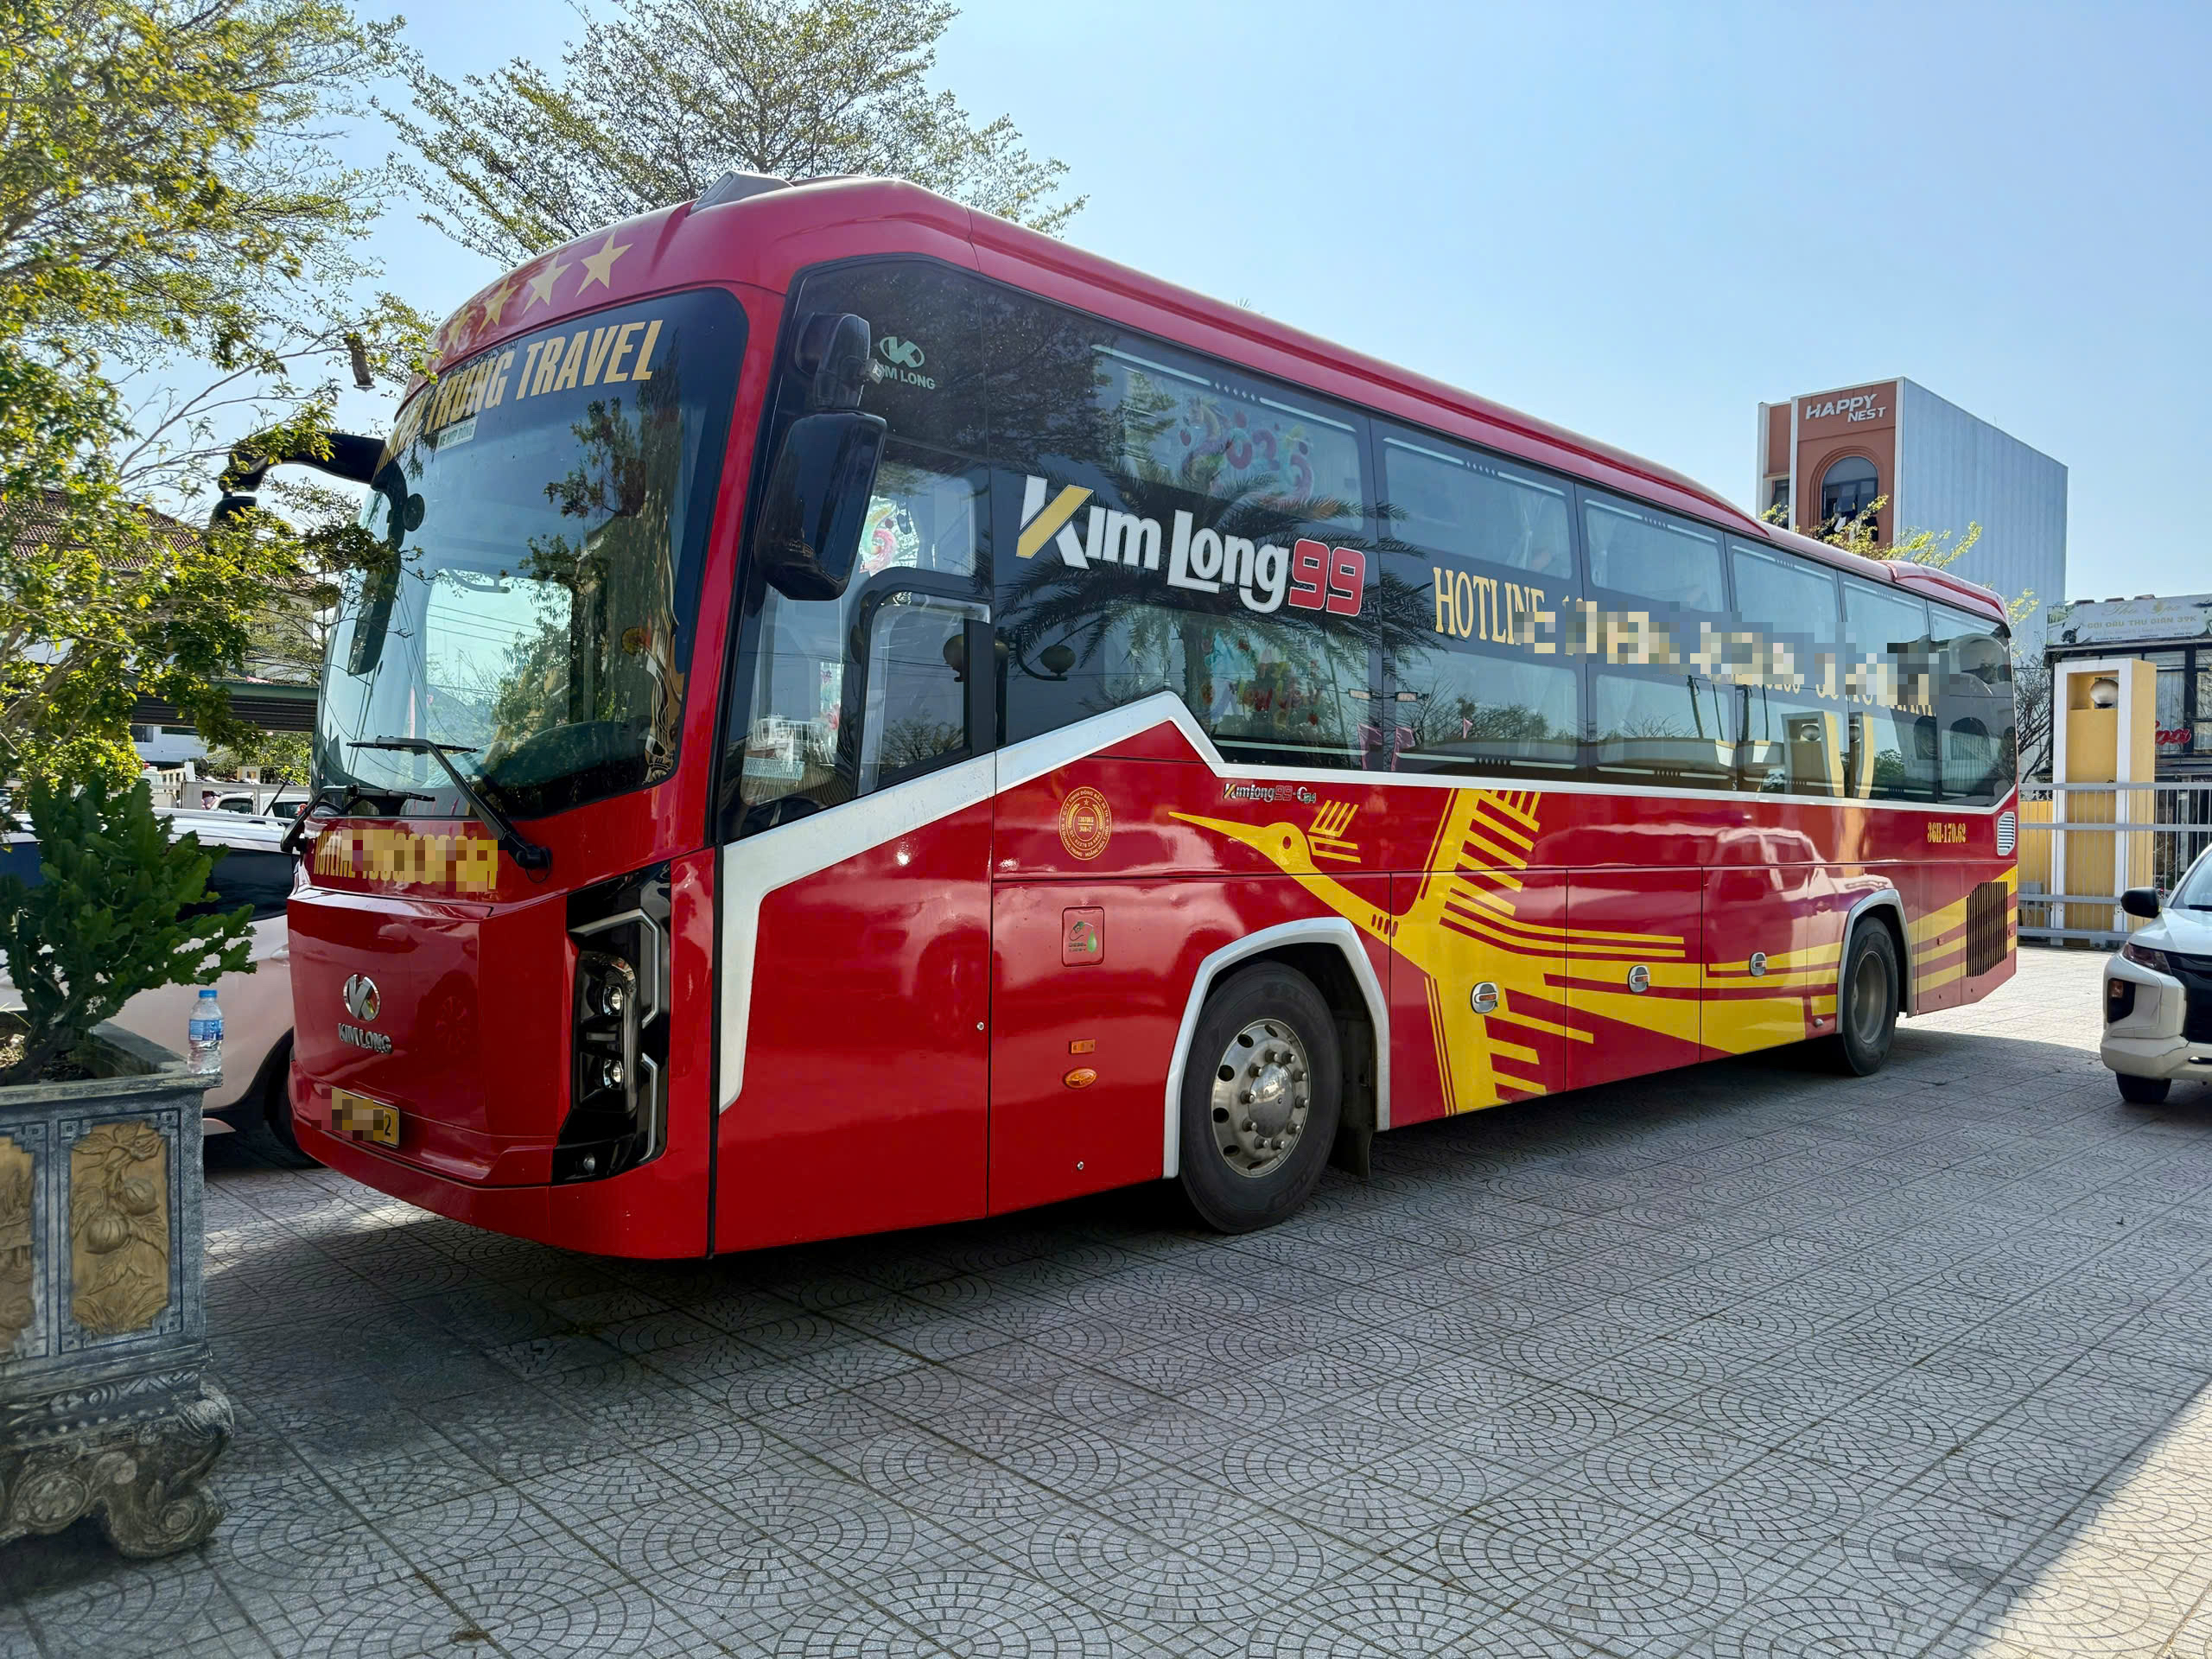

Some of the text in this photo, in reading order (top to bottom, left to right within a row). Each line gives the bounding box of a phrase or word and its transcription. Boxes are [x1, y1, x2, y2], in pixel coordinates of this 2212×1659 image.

[516, 320, 664, 401] TRAVEL
[899, 369, 936, 391] LONG
[1805, 393, 1878, 420] HAPPY
[1847, 406, 1886, 423] NEST
[2155, 719, 2192, 746] pa
[339, 1022, 392, 1053] KIM LONG
